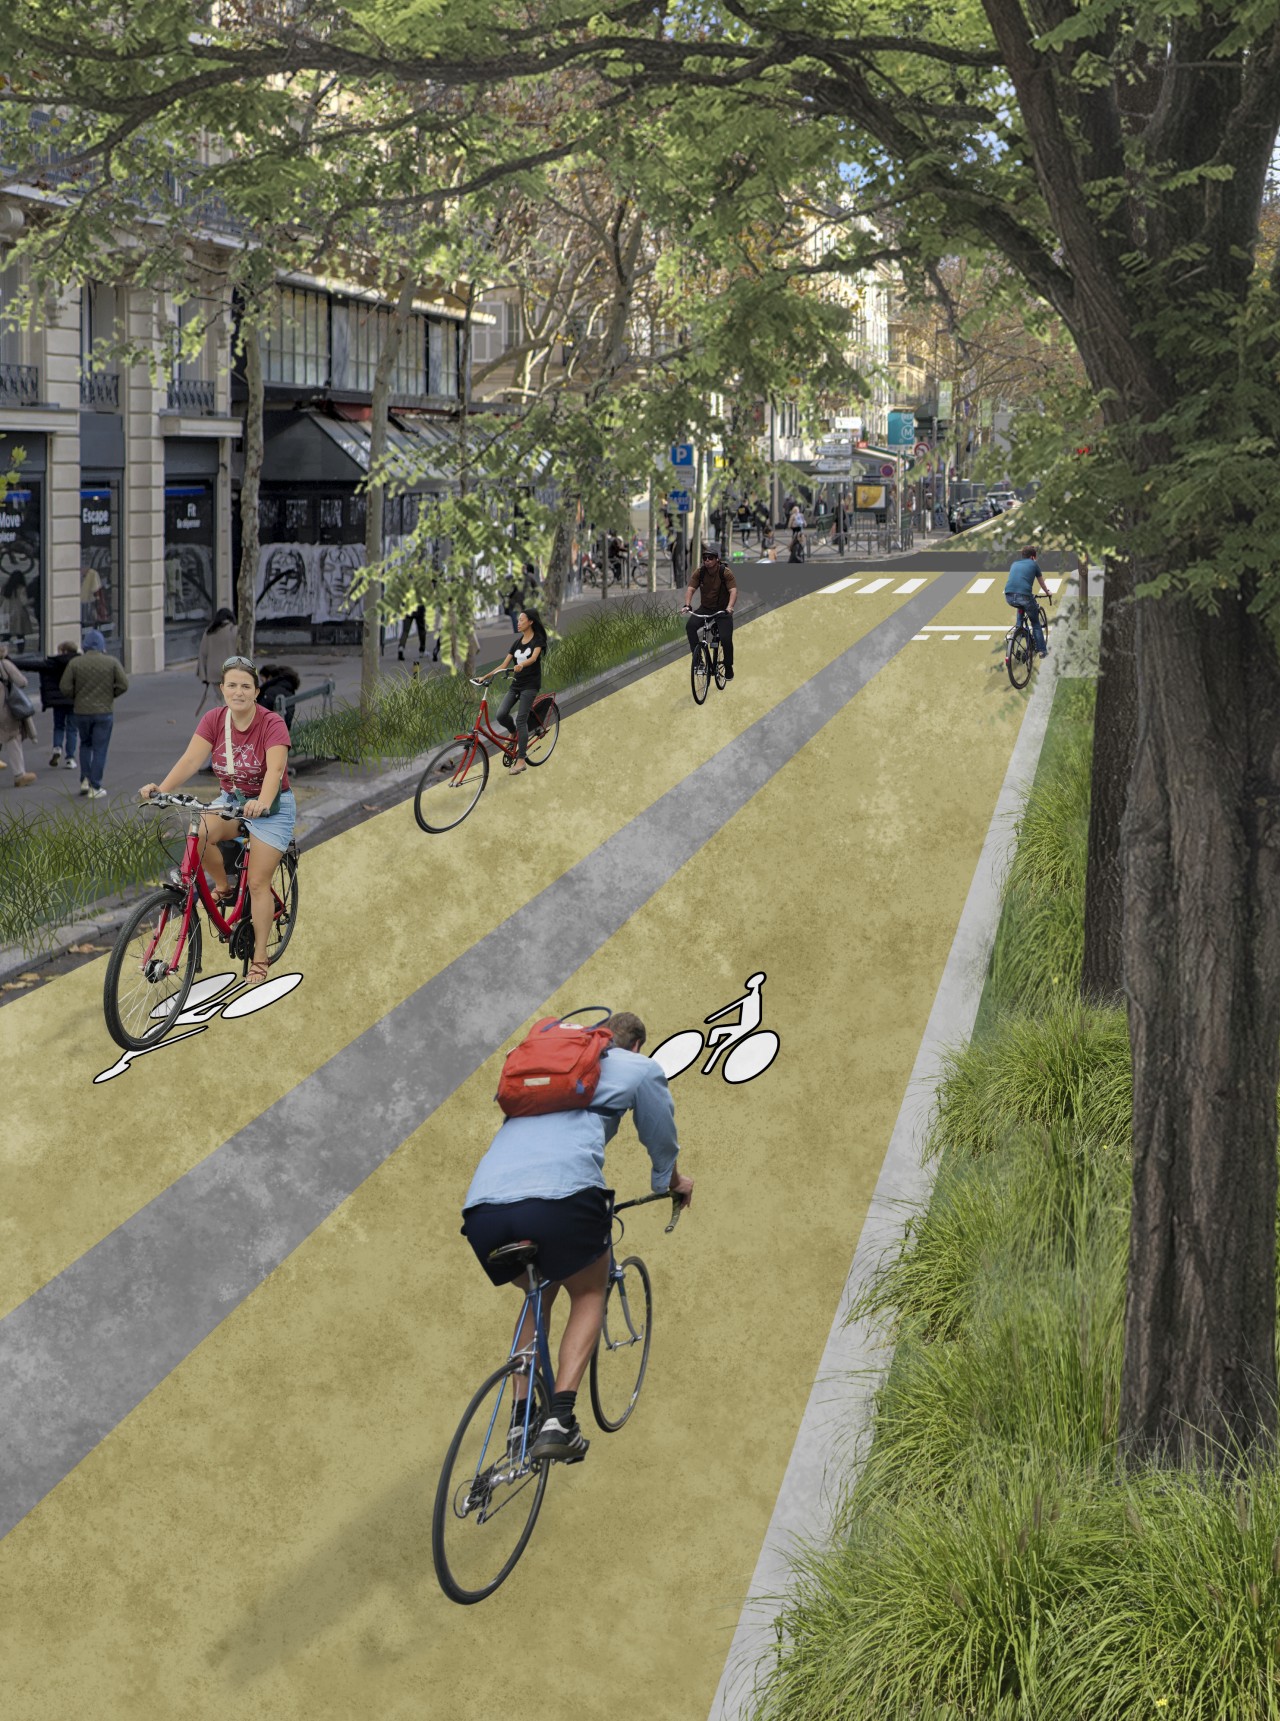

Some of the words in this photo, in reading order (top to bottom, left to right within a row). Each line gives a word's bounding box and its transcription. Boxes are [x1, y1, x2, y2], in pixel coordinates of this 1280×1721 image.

[904, 428, 912, 437] M
[676, 448, 688, 463] P
[83, 508, 109, 526] Escape
